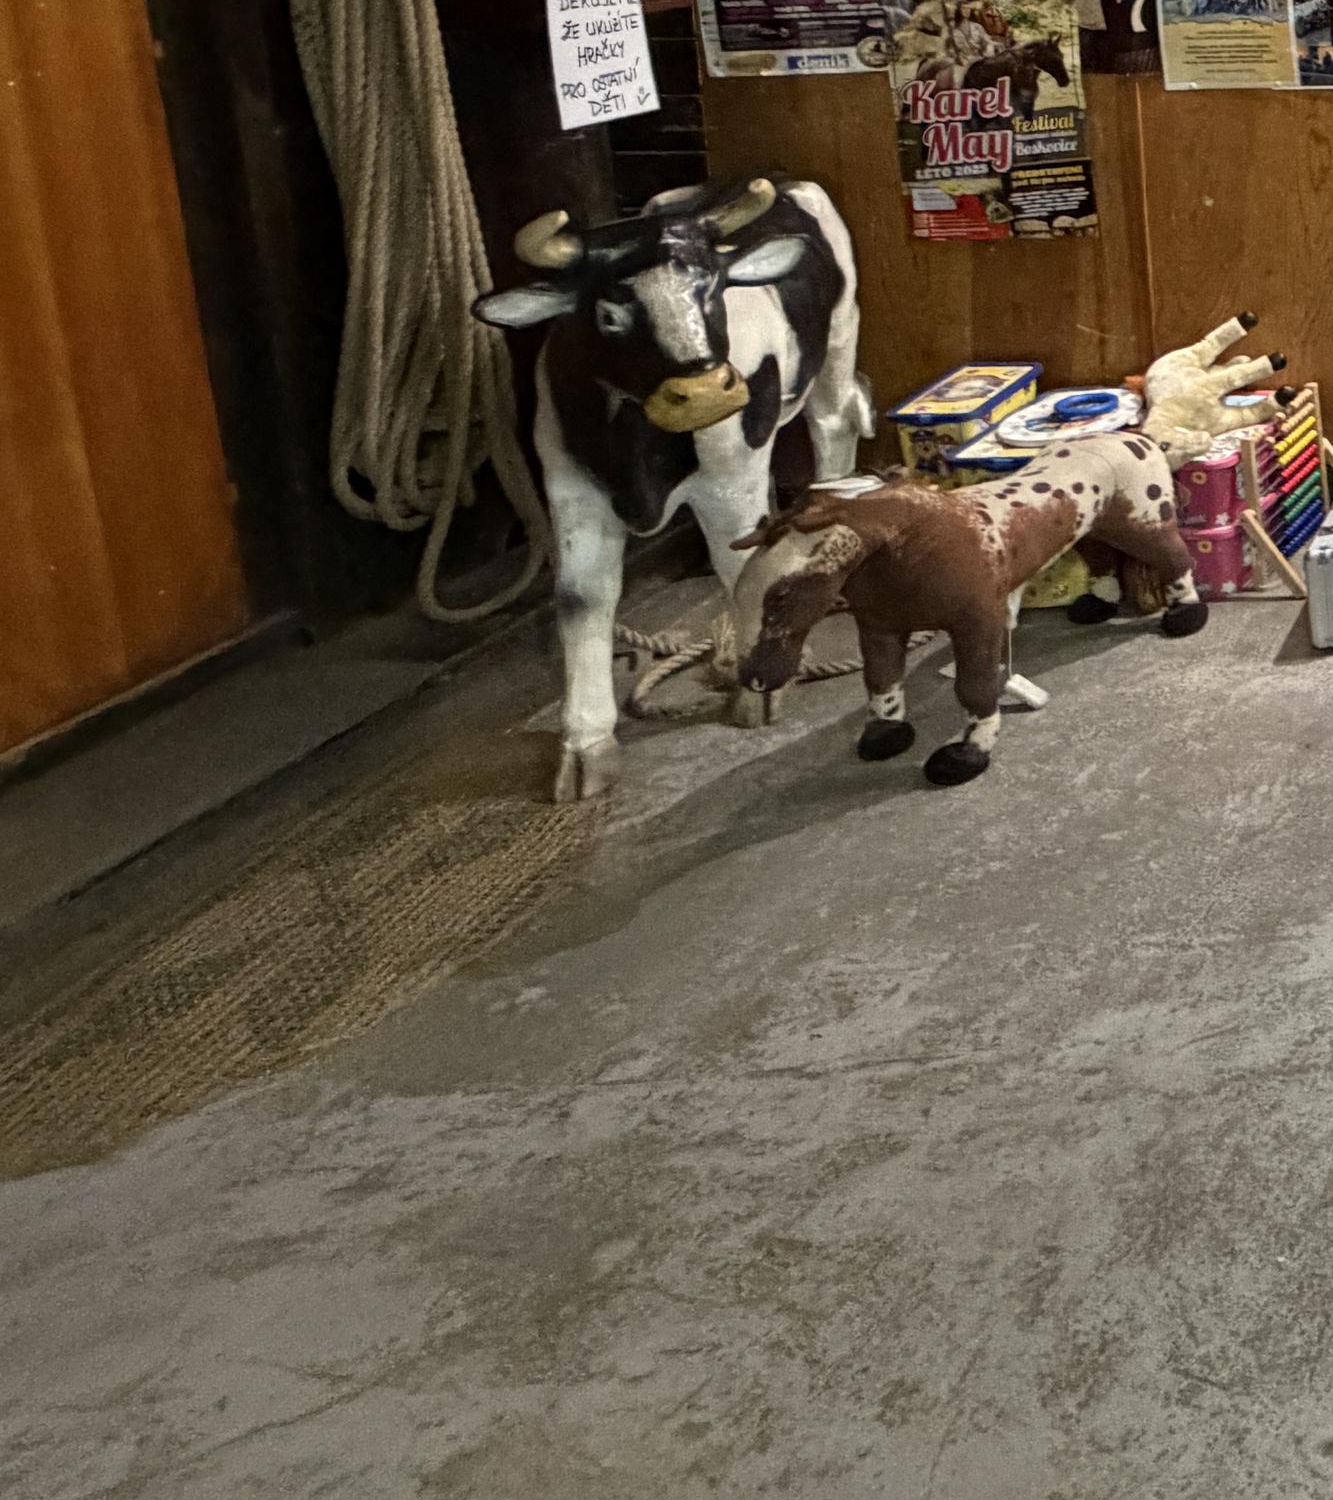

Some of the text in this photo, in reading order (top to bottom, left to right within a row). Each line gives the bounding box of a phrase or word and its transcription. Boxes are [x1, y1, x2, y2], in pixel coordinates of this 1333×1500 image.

[562, 20, 581, 41] ŽE
[577, 37, 625, 68] HRAČKY
[560, 57, 641, 100] PRO OSTATNÍ
[588, 90, 627, 117] DĚTI
[900, 75, 1014, 125] Karel
[921, 122, 1013, 174] May
